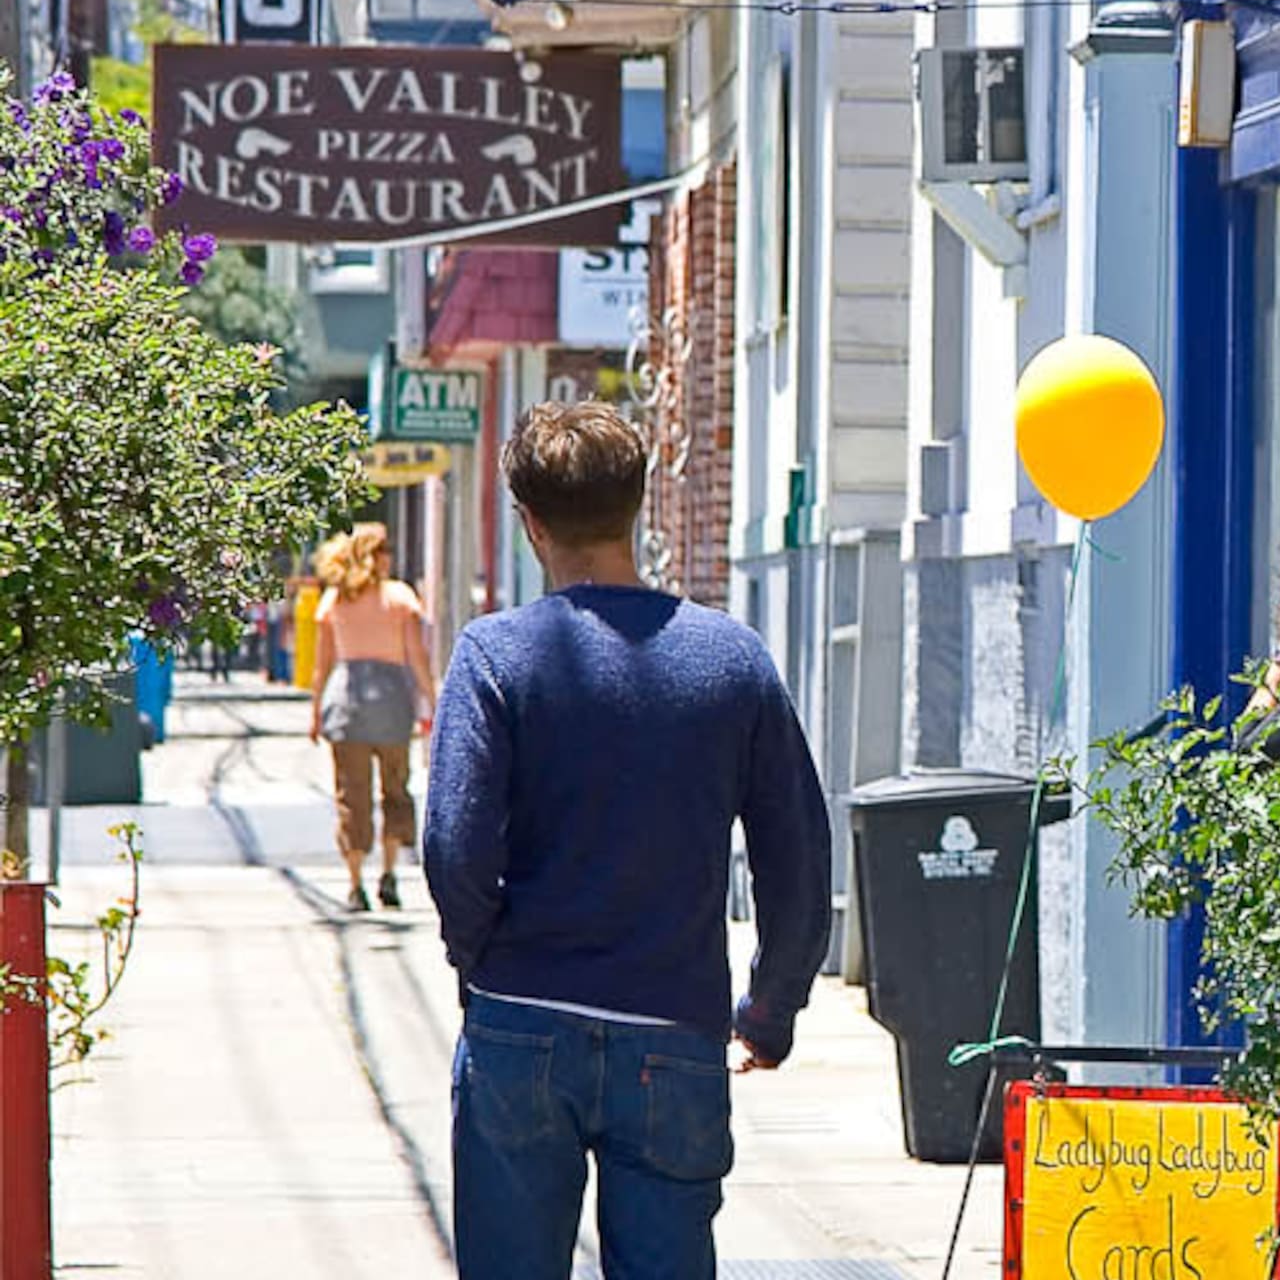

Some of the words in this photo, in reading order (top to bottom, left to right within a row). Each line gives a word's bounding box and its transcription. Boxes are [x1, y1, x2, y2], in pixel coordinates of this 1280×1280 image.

[178, 69, 315, 133] NOE
[331, 67, 595, 141] VALLEY
[175, 141, 597, 224] RESTAURANT
[316, 128, 456, 164] PIZZA
[400, 372, 478, 409] ATM
[1033, 1110, 1152, 1194] Ladybug
[1158, 1111, 1267, 1199] Ladybug
